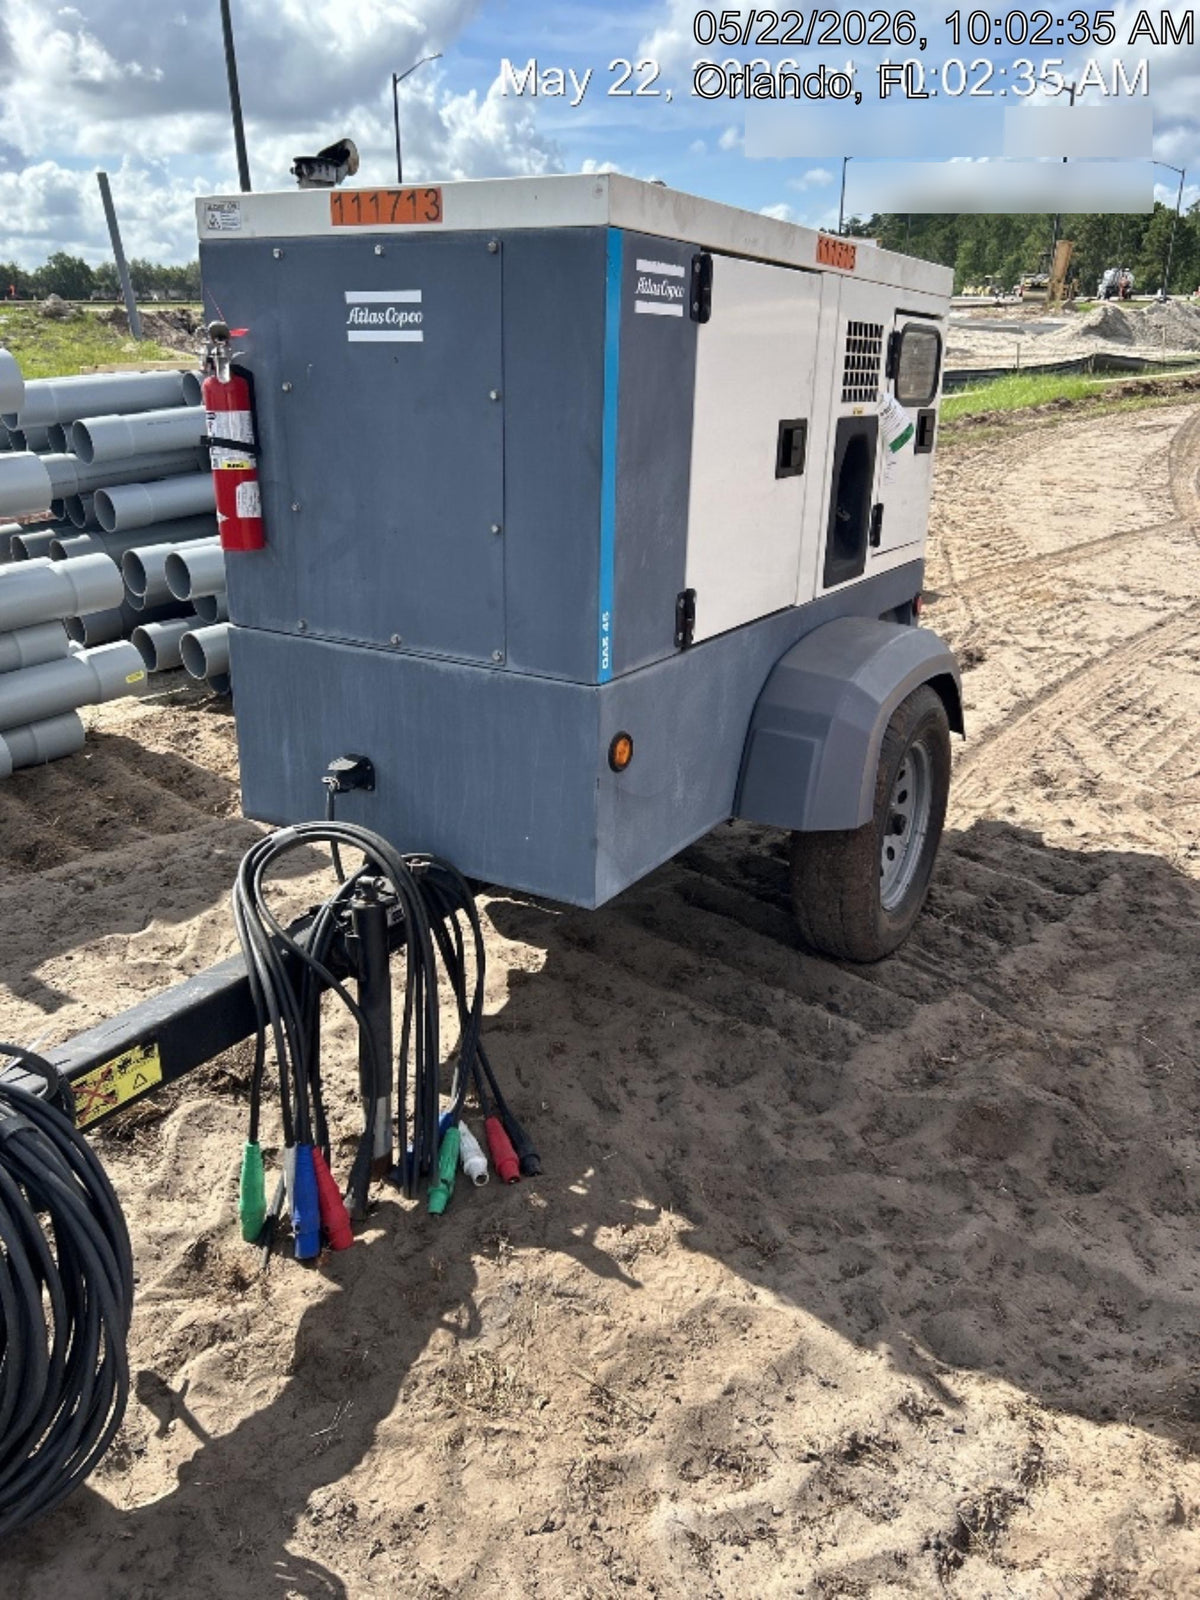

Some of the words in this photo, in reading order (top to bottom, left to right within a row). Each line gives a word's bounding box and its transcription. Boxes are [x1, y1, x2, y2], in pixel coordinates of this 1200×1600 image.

[334, 188, 440, 223] 111713
[346, 306, 385, 325] Atlas
[385, 306, 424, 328] Copco
